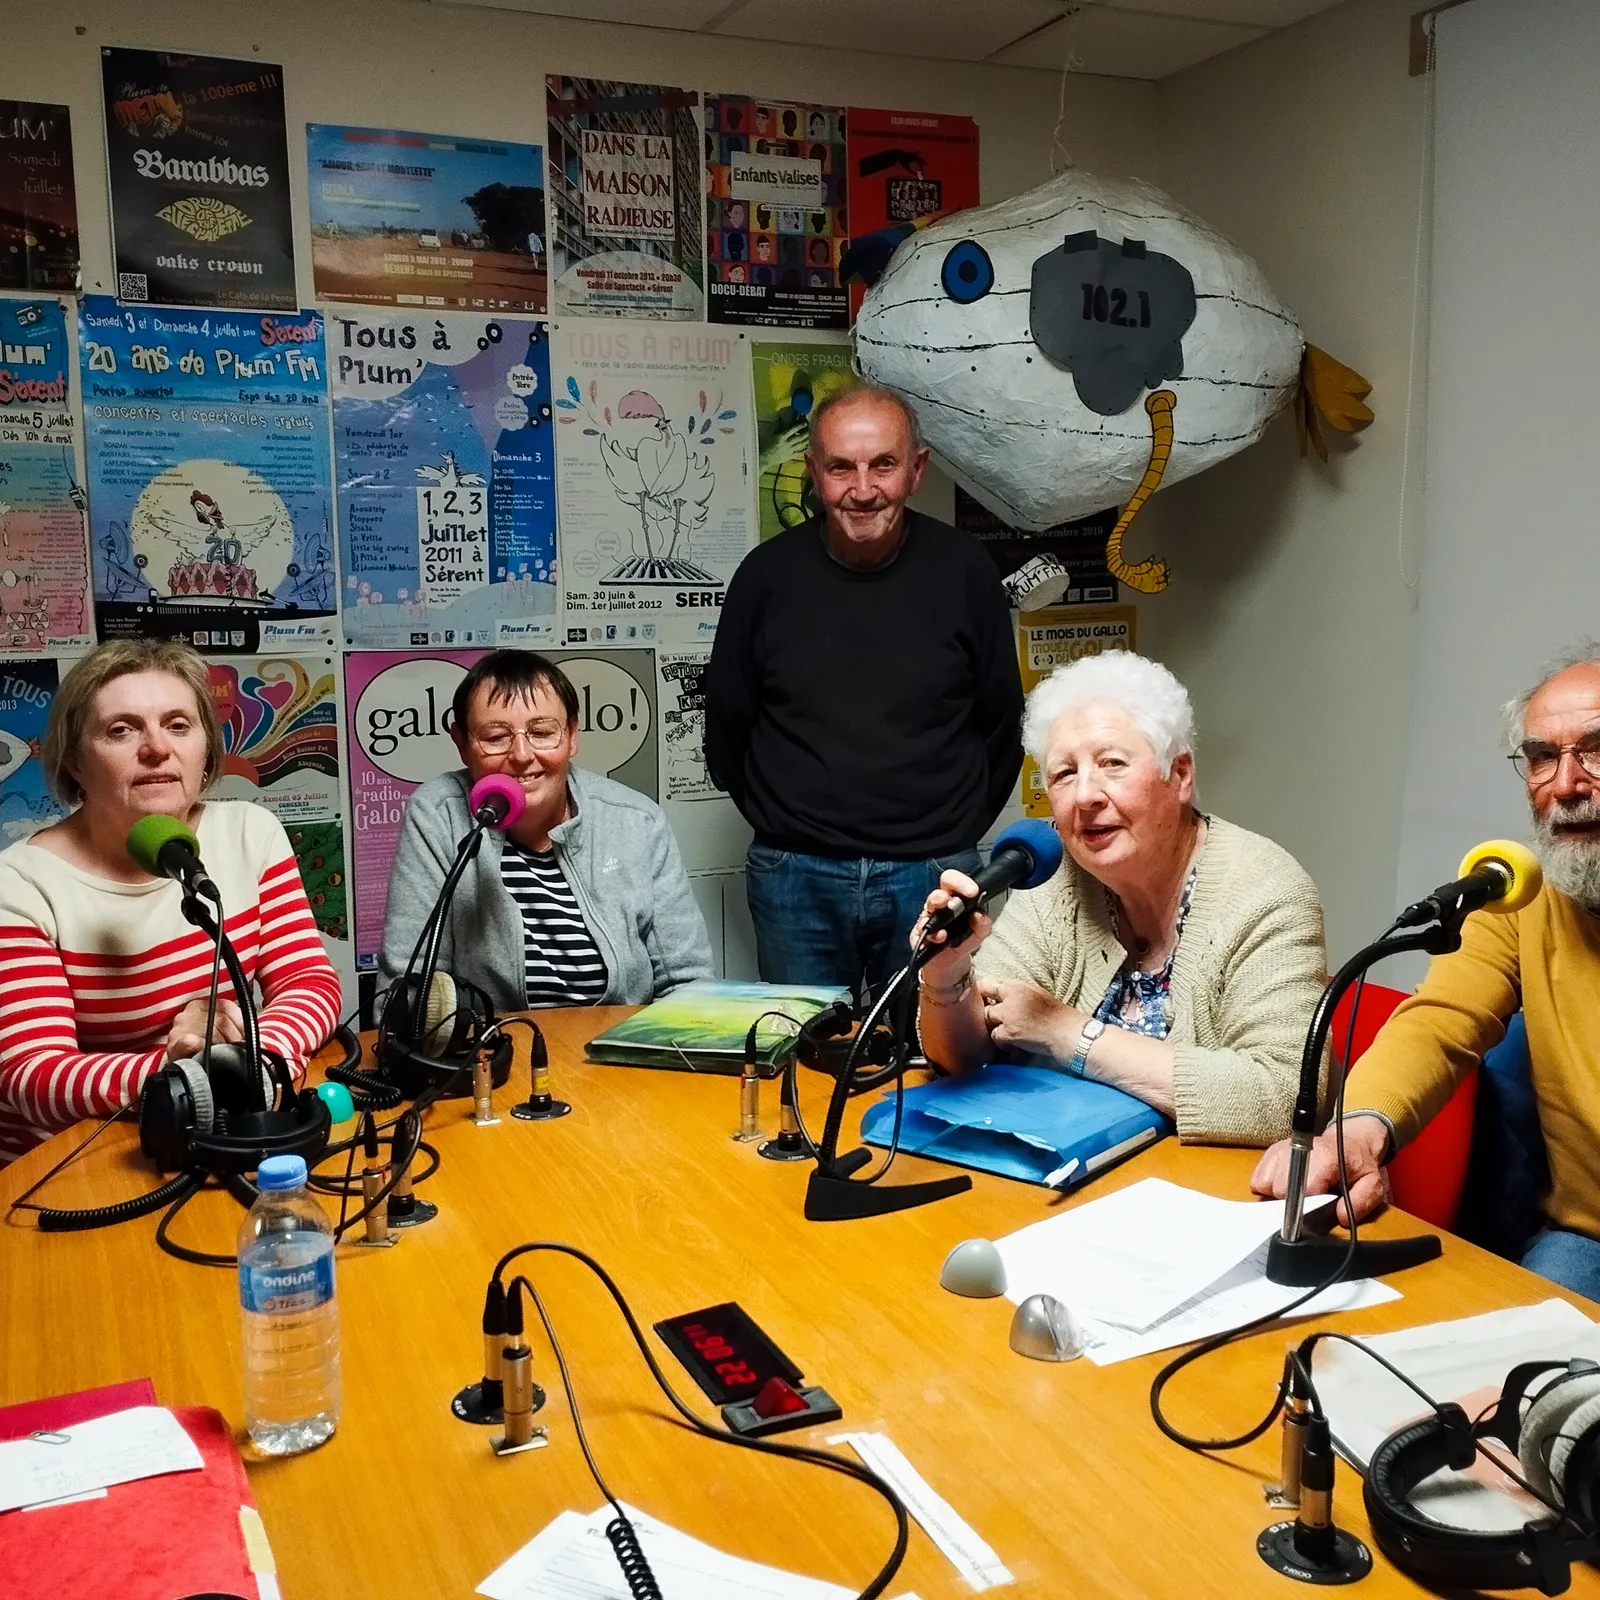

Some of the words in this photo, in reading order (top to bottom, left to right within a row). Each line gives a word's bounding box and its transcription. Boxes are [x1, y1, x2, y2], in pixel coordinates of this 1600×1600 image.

[200, 79, 258, 103] 100ème
[260, 73, 277, 90] !!!
[184, 125, 213, 141] Entrée
[584, 132, 636, 157] DANS
[643, 138, 671, 160] LA
[7, 151, 61, 167] Samedi
[27, 167, 37, 180] 2
[132, 147, 271, 188] Barabbas
[585, 169, 671, 197] MAISON
[733, 166, 778, 184] Enfants
[777, 168, 820, 186] Valises
[19, 179, 65, 196] Juillet
[586, 205, 674, 230] RADIEUSE
[156, 253, 200, 271] oaks
[207, 259, 264, 275] crown
[576, 268, 606, 278] Vendredi
[606, 270, 613, 278] 11
[614, 271, 639, 280] octobre
[640, 272, 655, 281] 2013
[661, 273, 682, 283] 20h30
[587, 280, 604, 290] Salle
[604, 281, 613, 291] de
[613, 282, 646, 292] Spectacle
[652, 283, 674, 293] Sérent
[711, 283, 767, 298] DOCU-DÉBAT
[217, 290, 228, 299] Le
[229, 290, 247, 300] Café
[249, 291, 259, 300] de
[261, 292, 270, 301] la
[1081, 283, 1152, 328] 102.1
[86, 313, 123, 328] Samedi
[125, 312, 136, 333] 3
[139, 317, 147, 330] et
[154, 318, 199, 335] Dimanche
[200, 319, 210, 337] 4
[213, 322, 240, 339] juillet
[339, 319, 417, 350] Tous
[432, 320, 452, 351] à
[566, 332, 630, 360] TOUS
[85, 341, 117, 374] 20
[131, 344, 170, 375] ans
[180, 349, 205, 376] de
[285, 349, 321, 382] FM
[582, 360, 598, 369] fête
[601, 361, 611, 369] de
[613, 361, 621, 369] la
[623, 361, 644, 370] radio
[645, 362, 689, 371] associative
[771, 352, 810, 367] ONDES
[338, 355, 423, 385] Plum'
[512, 372, 535, 381] Entrée
[516, 381, 532, 389] libre
[93, 383, 127, 398] Portes
[134, 385, 174, 398] ouvertes
[238, 389, 260, 405] Expo
[265, 392, 280, 403] des
[285, 393, 298, 403] 20
[301, 394, 319, 404] ans
[33, 412, 43, 428] 5
[47, 415, 74, 428] juillet
[94, 404, 161, 421] concerts
[170, 406, 186, 423] et
[191, 408, 267, 428] spectacles
[24, 431, 39, 442] 10h
[43, 431, 54, 443] du
[345, 427, 386, 438] Vendredi
[388, 427, 404, 440] 1er
[493, 450, 533, 463] Dimanche
[535, 452, 542, 463] 3
[383, 469, 390, 480] 2
[423, 490, 439, 517] 1,
[443, 490, 464, 518] 2,
[469, 491, 482, 516] 3
[1081, 525, 1104, 536] 2010
[205, 536, 242, 565] 20
[425, 547, 462, 564] 2011
[472, 546, 484, 563] à
[425, 564, 485, 584] Sérent
[566, 591, 590, 600] Sam.
[593, 591, 606, 600] 30
[608, 590, 626, 602] juin
[628, 591, 636, 600] &
[566, 601, 589, 610] Dim.
[591, 601, 607, 610] 1er
[609, 600, 636, 612] juillet
[638, 600, 663, 609] 2012
[264, 625, 296, 635] Plum
[296, 626, 316, 635] Fm
[500, 624, 525, 633] Plum
[526, 624, 540, 632] Fm
[1031, 630, 1043, 641] LE
[1046, 628, 1075, 640] MOIS
[1077, 627, 1091, 638] DU
[1093, 625, 1127, 637] GALLO
[1031, 641, 1069, 654] MOUEZ
[3, 675, 52, 709] TOUS
[578, 684, 638, 732] lo!
[361, 770, 376, 786] 10
[377, 777, 392, 785] ans
[262, 795, 291, 803] Samedi
[292, 794, 302, 802] 05
[303, 793, 329, 801] Juillet
[362, 785, 401, 802] radio
[263, 1270, 316, 1289] ondine
